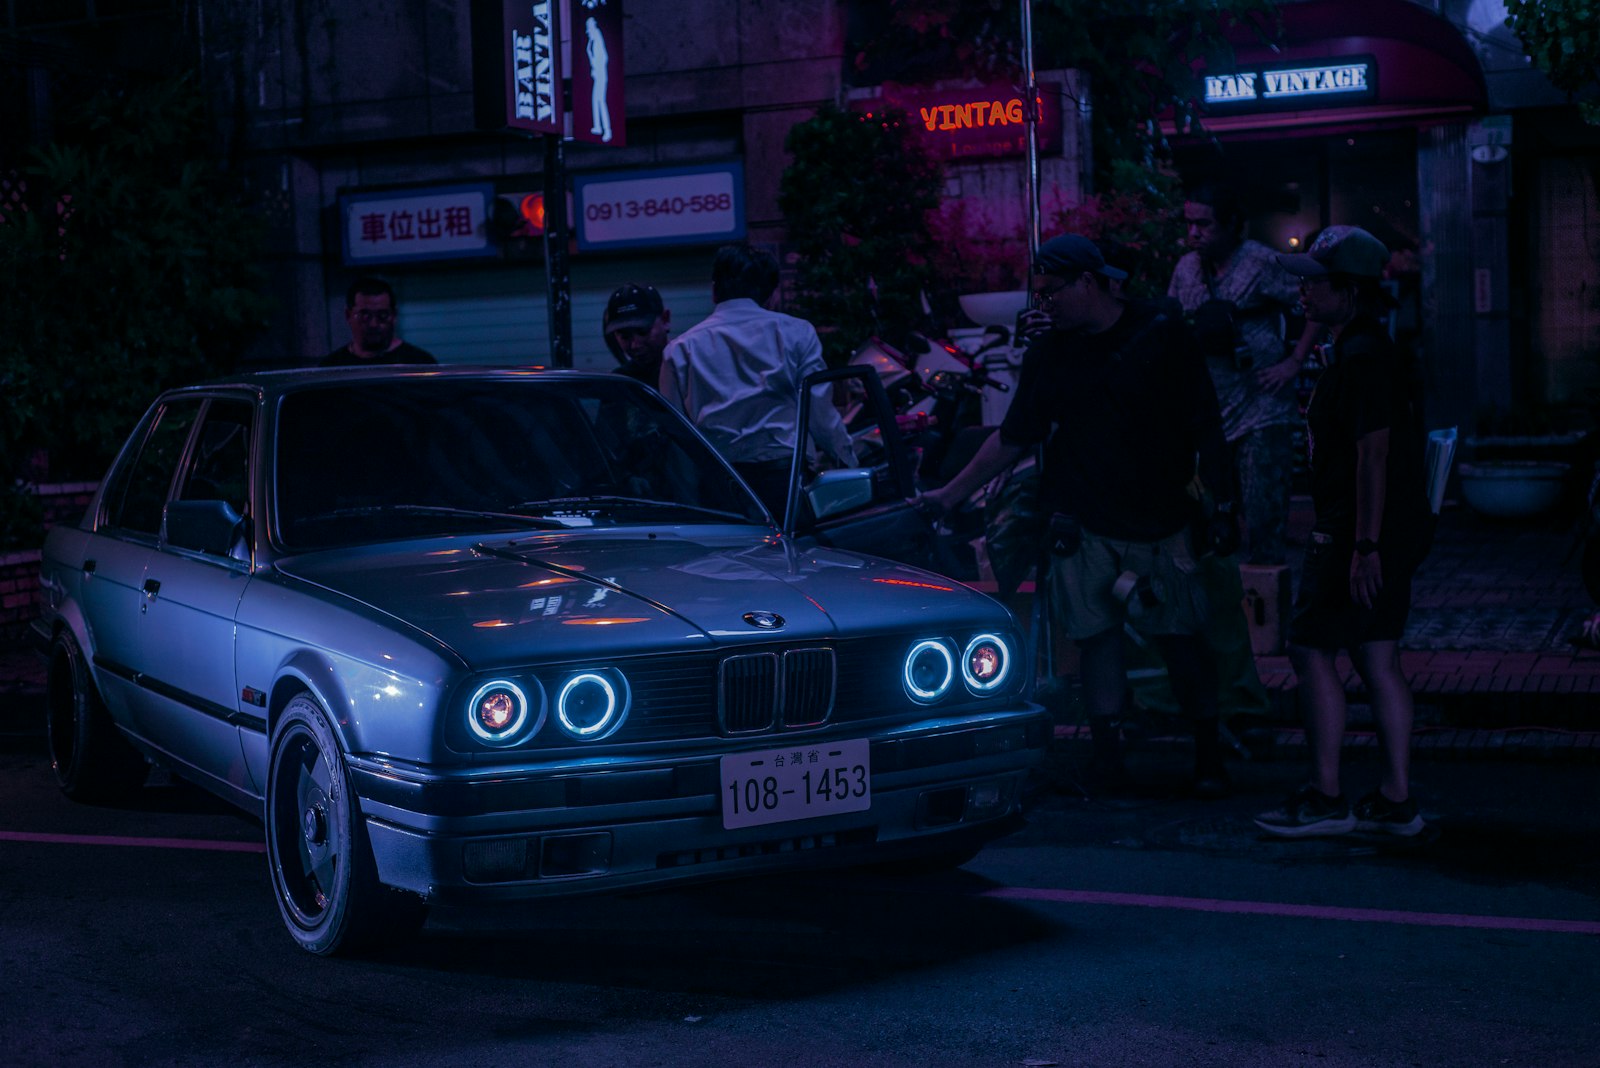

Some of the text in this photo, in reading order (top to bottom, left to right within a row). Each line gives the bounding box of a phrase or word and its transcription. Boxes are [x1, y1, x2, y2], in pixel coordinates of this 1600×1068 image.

[514, 32, 535, 120] BAR
[1204, 64, 1368, 102] BAR VINTAGE
[920, 98, 1043, 131] VINTAG
[586, 193, 731, 220] 0913-840-588
[361, 207, 472, 243] 車位出租
[774, 750, 820, 768] 台灣省
[729, 765, 867, 814] 108-1453
